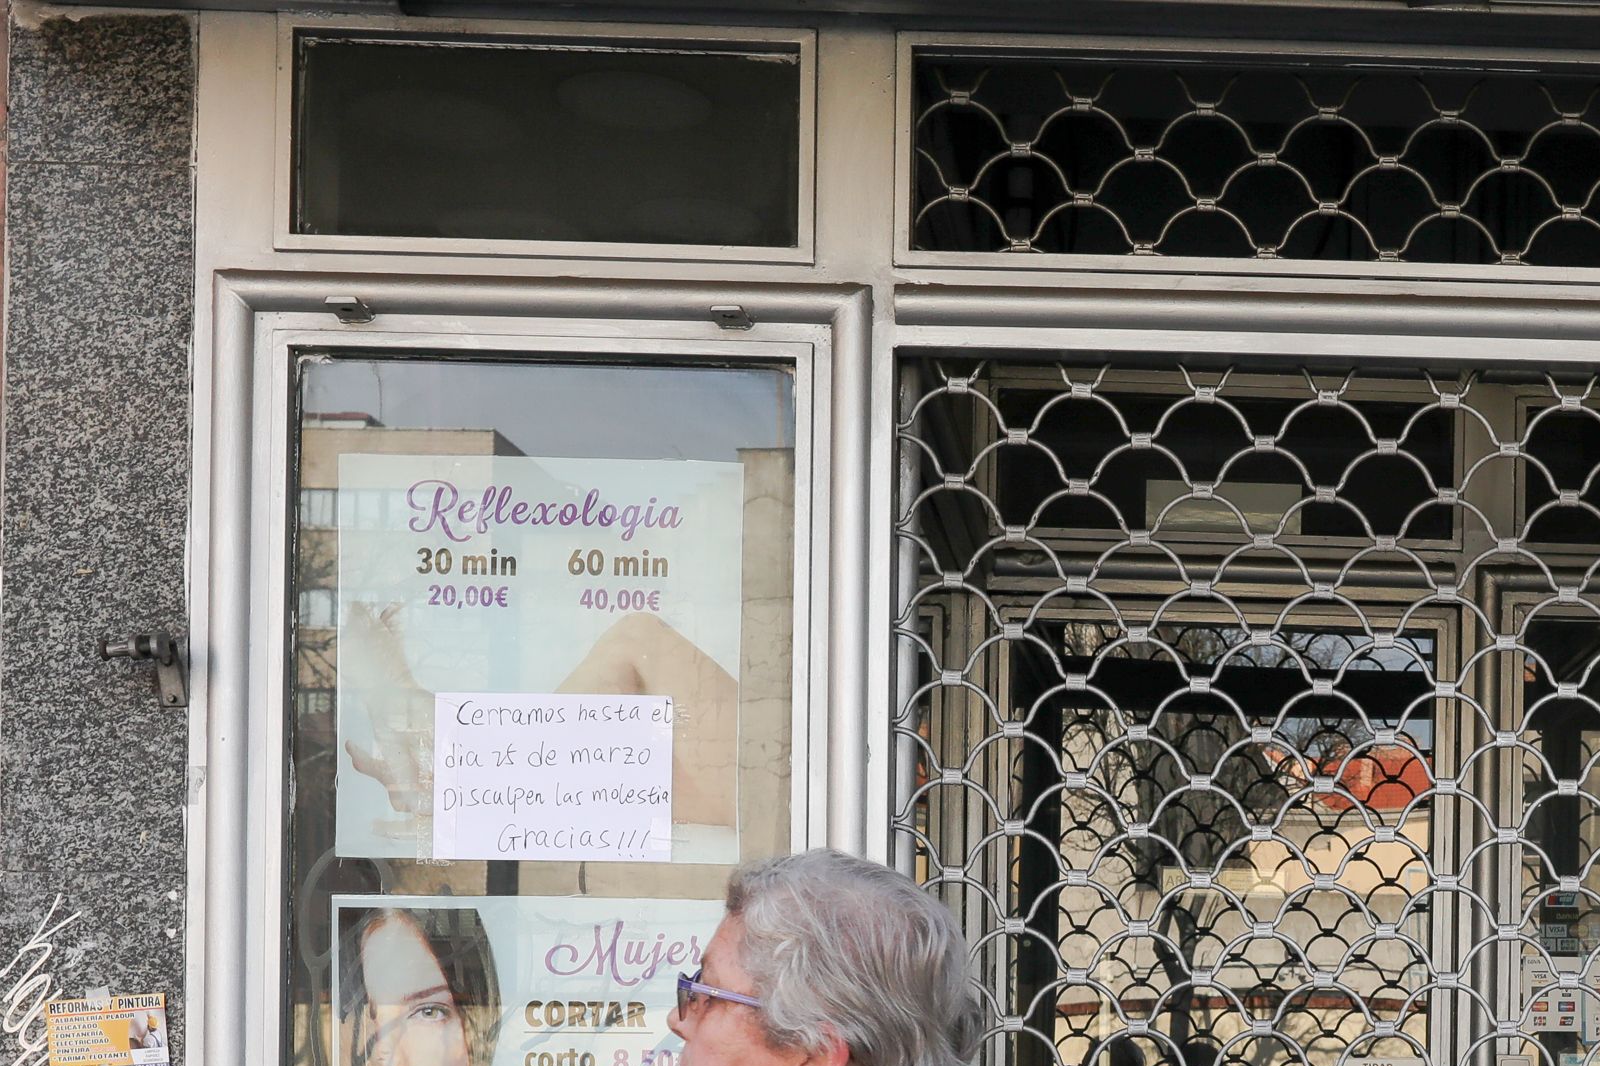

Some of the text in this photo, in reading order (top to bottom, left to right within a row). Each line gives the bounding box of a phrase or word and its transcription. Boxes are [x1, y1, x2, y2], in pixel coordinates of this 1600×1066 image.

[407, 479, 684, 542] Reflexologia
[416, 548, 517, 577] 30 min
[567, 549, 669, 578] 60 min
[428, 585, 509, 609] 20,00€
[579, 588, 660, 613] 40,00€
[456, 700, 566, 726] Cerramos
[578, 703, 640, 722] hasta
[527, 740, 558, 768] de
[570, 746, 651, 766] marzo
[443, 782, 669, 814] Disculpen las molestia
[49, 1000, 103, 1014] REFORMAS
[118, 996, 161, 1009] PINTURA
[523, 1000, 647, 1028] CORTAR
